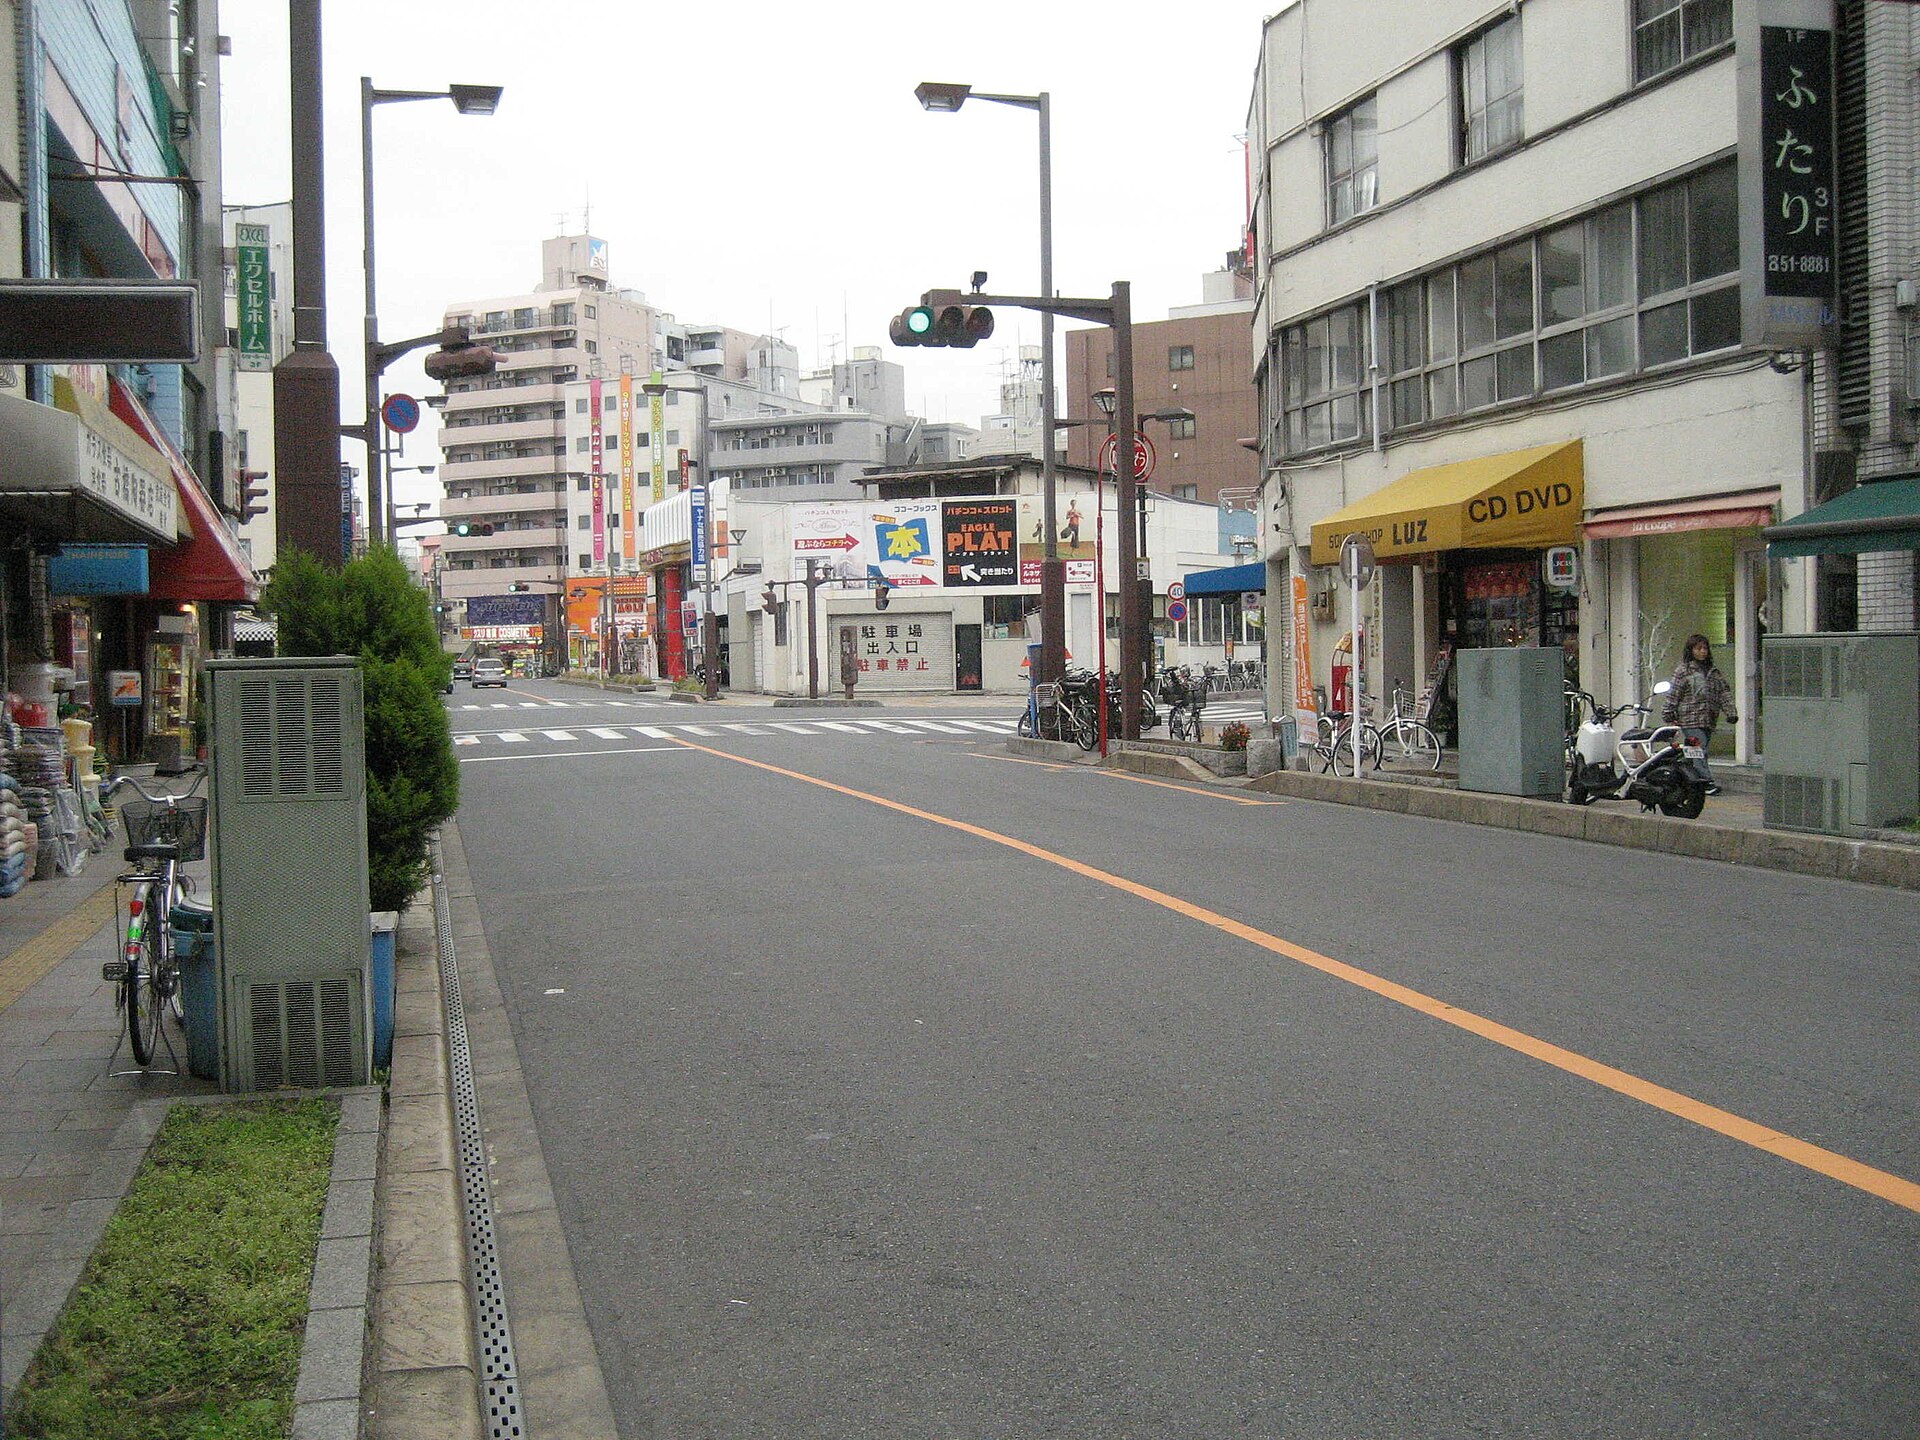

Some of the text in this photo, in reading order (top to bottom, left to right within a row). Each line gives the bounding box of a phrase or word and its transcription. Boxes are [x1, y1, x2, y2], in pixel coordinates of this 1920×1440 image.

[1776, 65, 1817, 235] ふたり
[1814, 187, 1829, 236] 3F
[245, 250, 264, 350] エクセルホーム
[1468, 483, 1572, 523] CD DVD
[961, 523, 995, 532] EAGLE
[1392, 519, 1428, 546] LUZ
[886, 526, 922, 558] 本
[947, 531, 1013, 552] PLAT
[980, 568, 1014, 576] 突き当たり
[1172, 587, 1183, 596] 40
[499, 627, 530, 638] COSMETIC
[861, 625, 922, 639] 駐車場
[866, 641, 918, 655] 出入口
[857, 657, 929, 672] 駐車禁止
